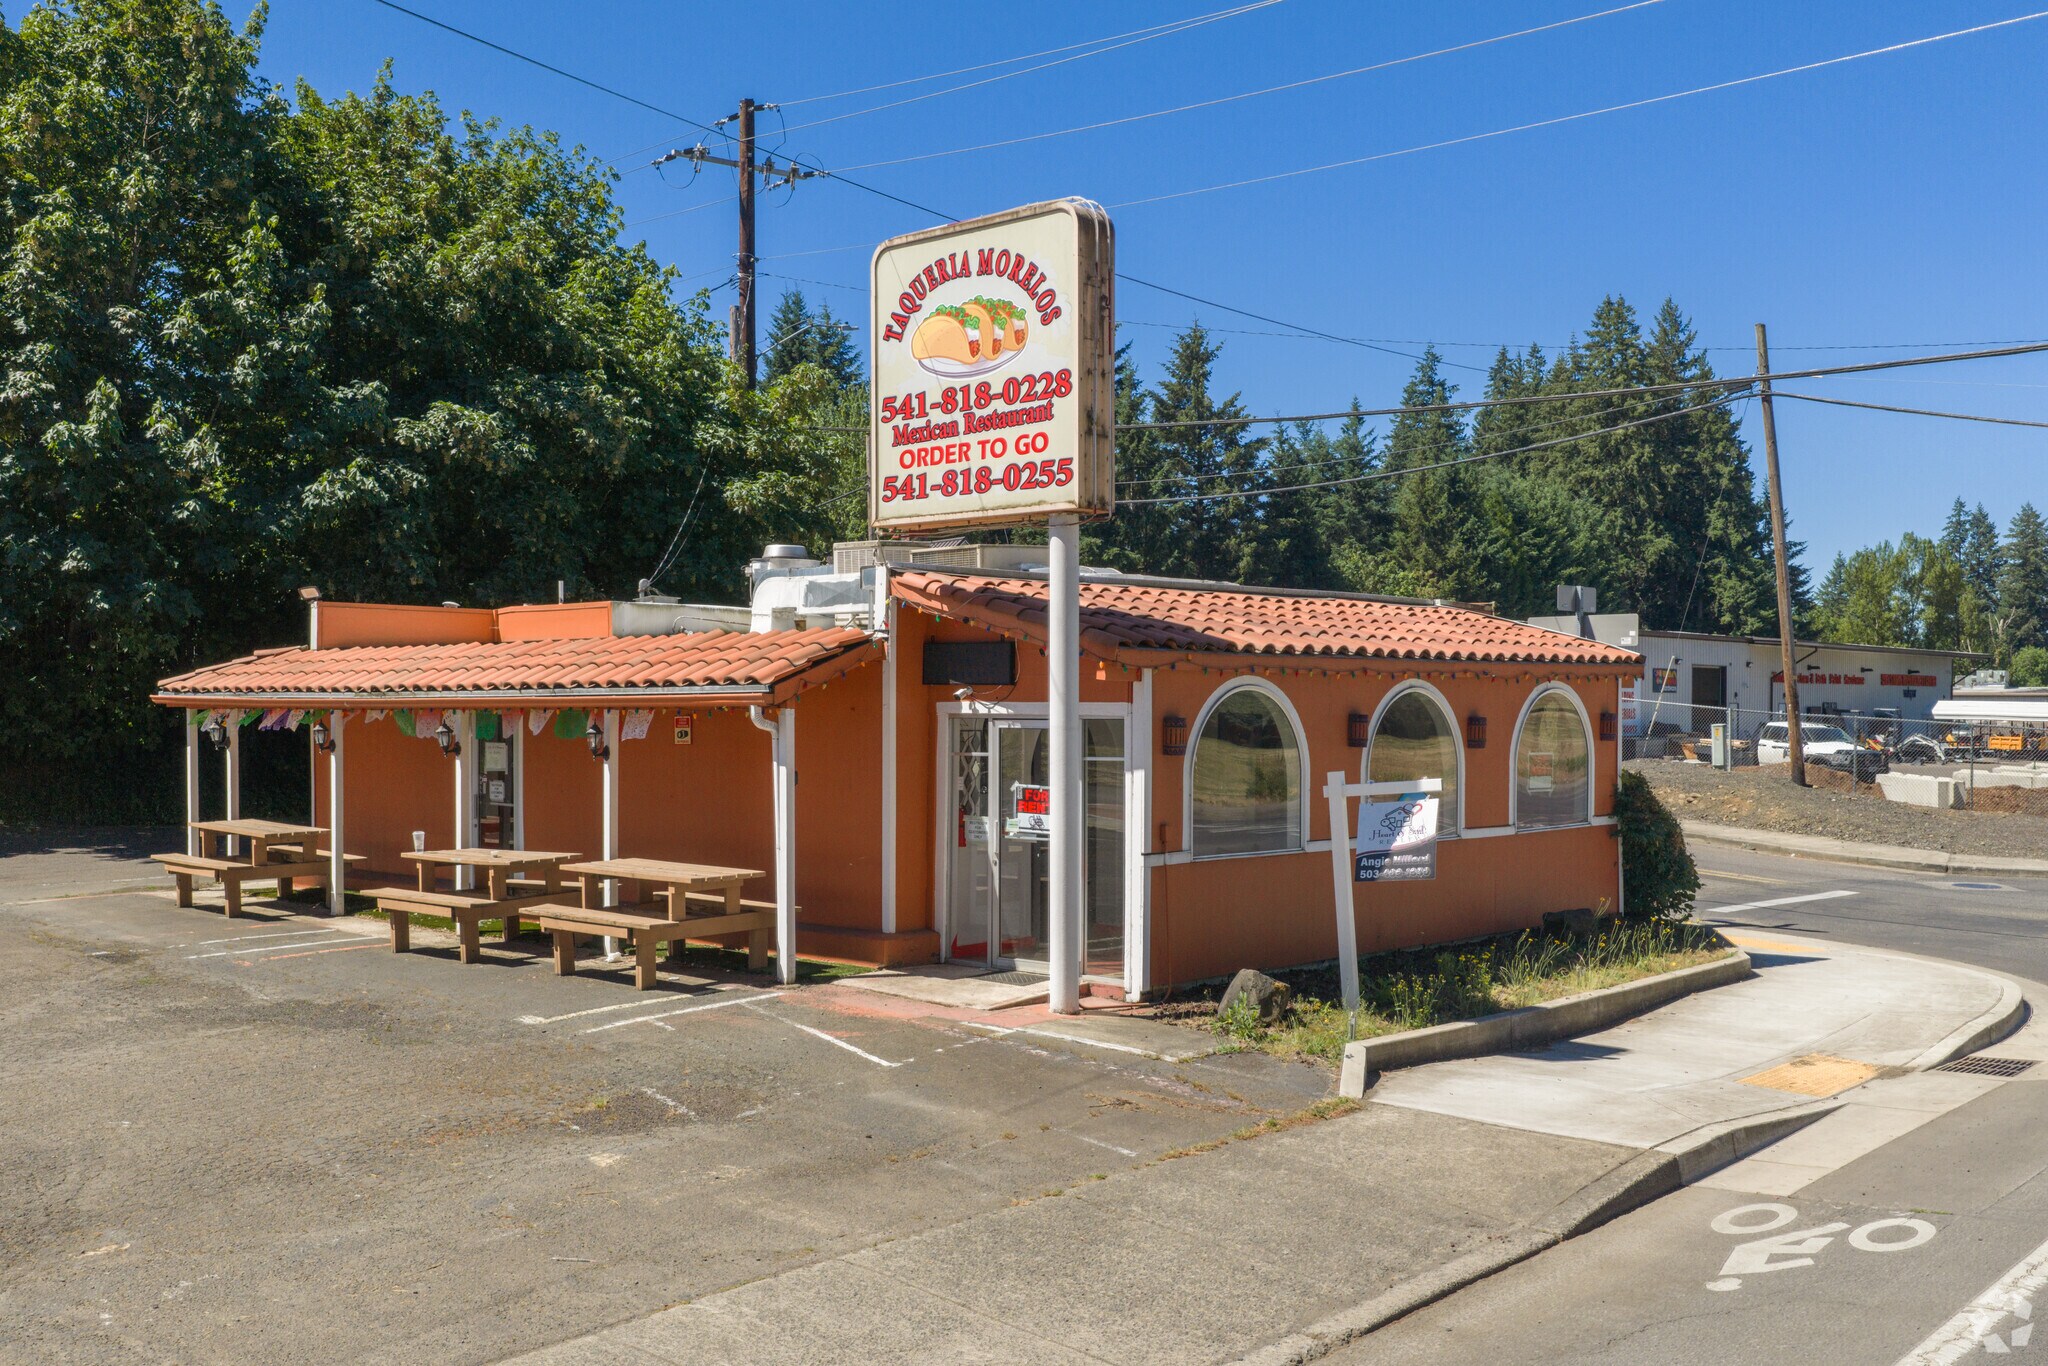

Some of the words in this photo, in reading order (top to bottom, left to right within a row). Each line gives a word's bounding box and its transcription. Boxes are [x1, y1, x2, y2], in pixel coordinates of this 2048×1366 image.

[883, 250, 971, 343] TAQUERIA
[977, 248, 1062, 326] MORELOS
[881, 369, 1073, 423] 541-818-0228
[892, 419, 959, 447] Mexican
[963, 399, 1054, 436] Restaurant
[899, 443, 971, 470] ORDER
[977, 437, 1008, 460] TO
[1014, 431, 1049, 456] GO
[882, 457, 1074, 502] 541-818-0255
[1025, 789, 1049, 802] FOR
[1369, 830, 1395, 840] Heart
[1360, 856, 1392, 867] Angie
